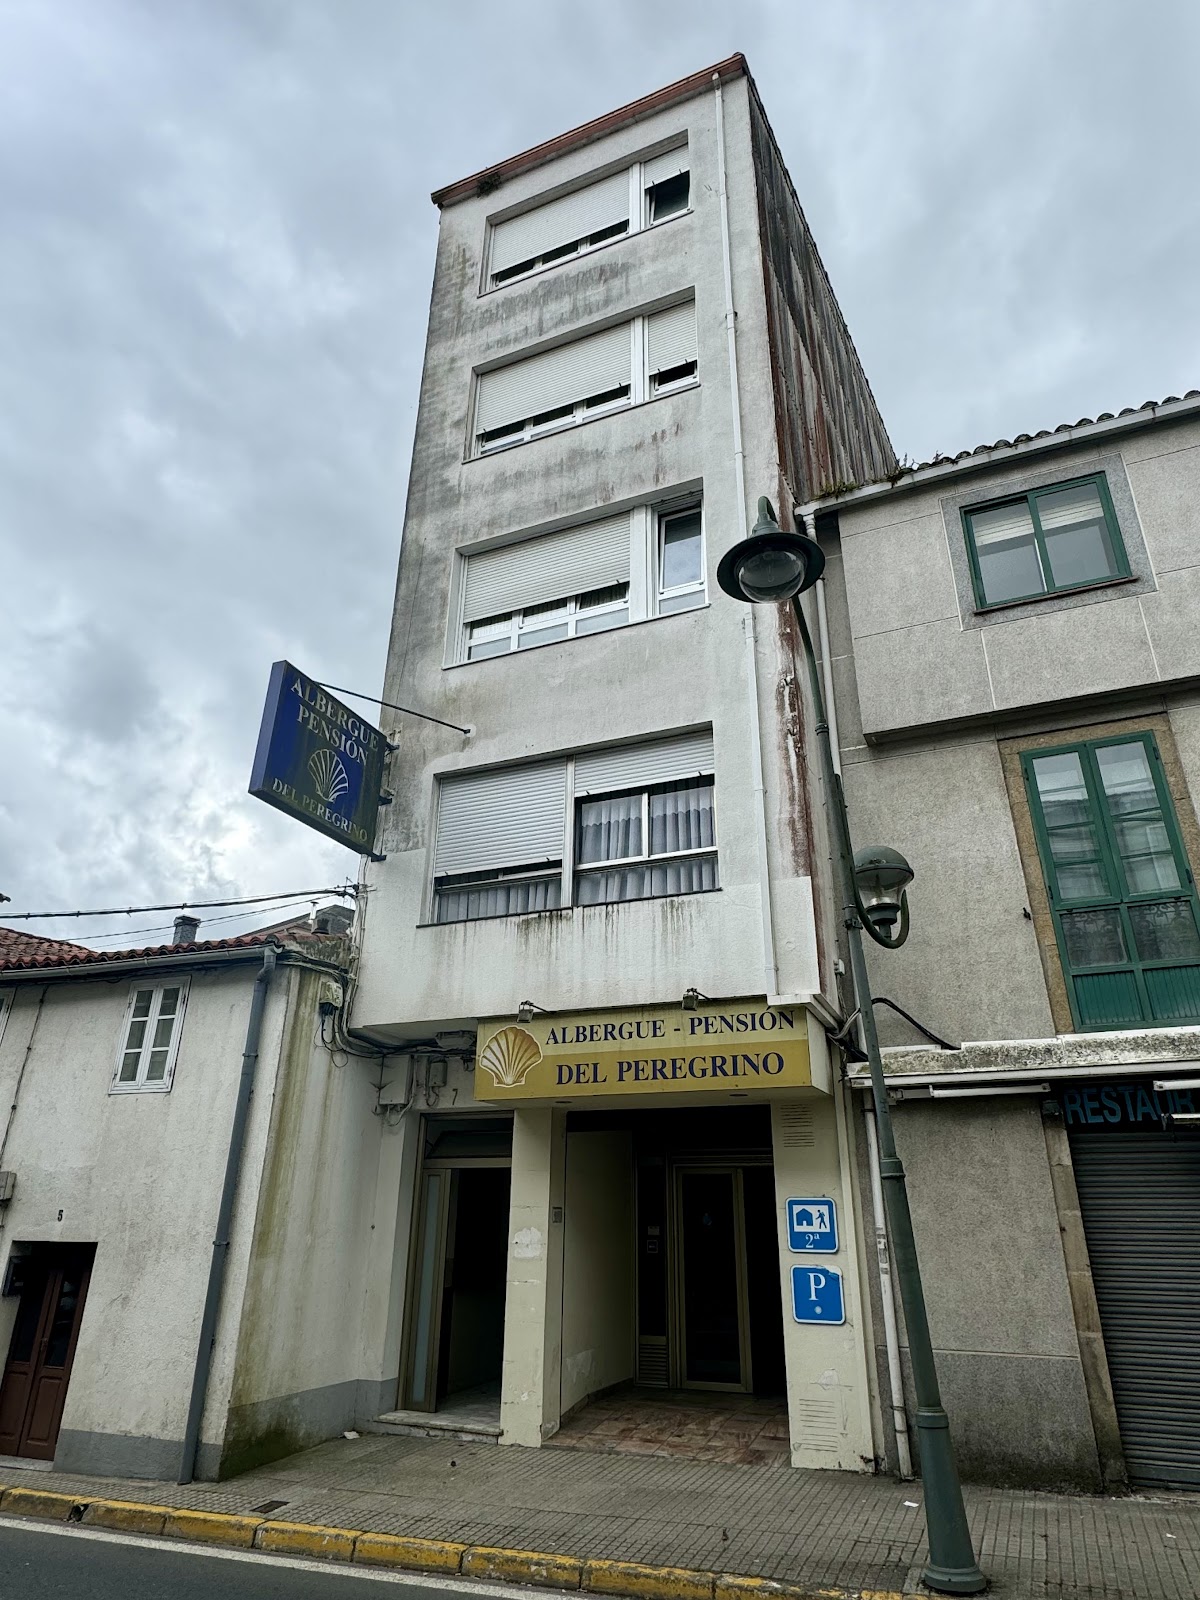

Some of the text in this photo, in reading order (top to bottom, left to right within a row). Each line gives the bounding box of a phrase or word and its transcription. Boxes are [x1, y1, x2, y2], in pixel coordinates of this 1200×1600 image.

[291, 678, 379, 750] ALBERGUE
[297, 704, 369, 765] PENSIÓN
[273, 778, 298, 803] DEL
[302, 796, 368, 842] PEREGRINO
[545, 1019, 666, 1045] ALBERGUE
[688, 1006, 796, 1036] PENSIÓN
[556, 1051, 785, 1086] DEL PEREGRINO
[451, 1088, 459, 1106] 7
[57, 1209, 64, 1222] 5
[807, 1272, 826, 1301] P
